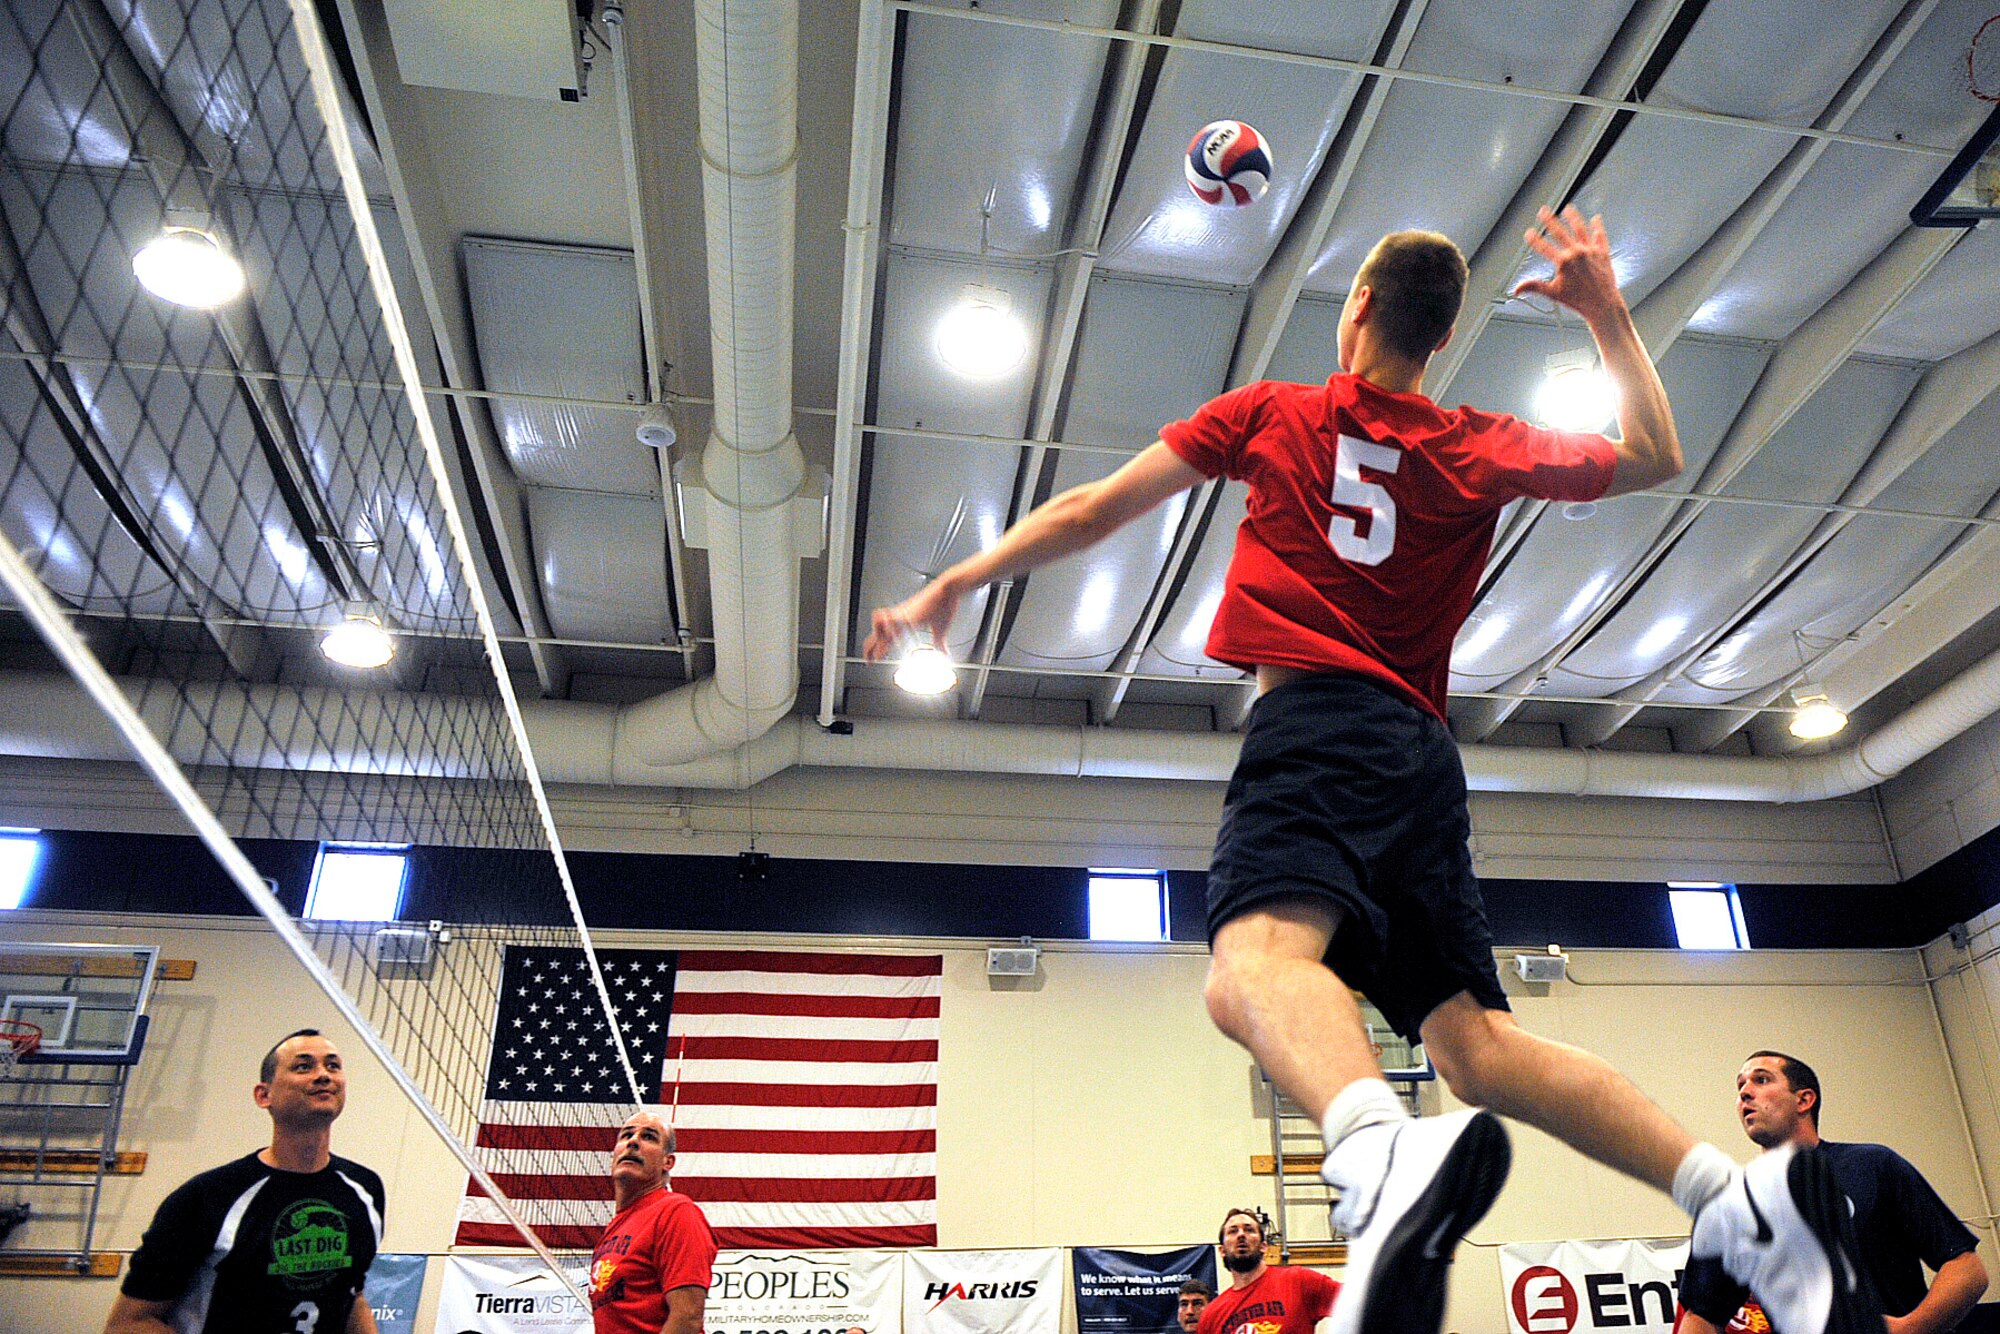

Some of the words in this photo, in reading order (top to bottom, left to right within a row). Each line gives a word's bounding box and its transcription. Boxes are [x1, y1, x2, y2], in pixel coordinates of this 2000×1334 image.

[1328, 433, 1401, 567] 5
[278, 1240, 311, 1257] LAST
[317, 1236, 343, 1253] DIG
[707, 1271, 850, 1300] PEOPLES
[1080, 1274, 1097, 1284] We
[1098, 1273, 1127, 1284] know
[1080, 1287, 1092, 1296] to
[1093, 1287, 1123, 1296] serve.
[1124, 1285, 1140, 1296] Let
[1142, 1287, 1154, 1296] us
[923, 1280, 1039, 1315] HARRIS
